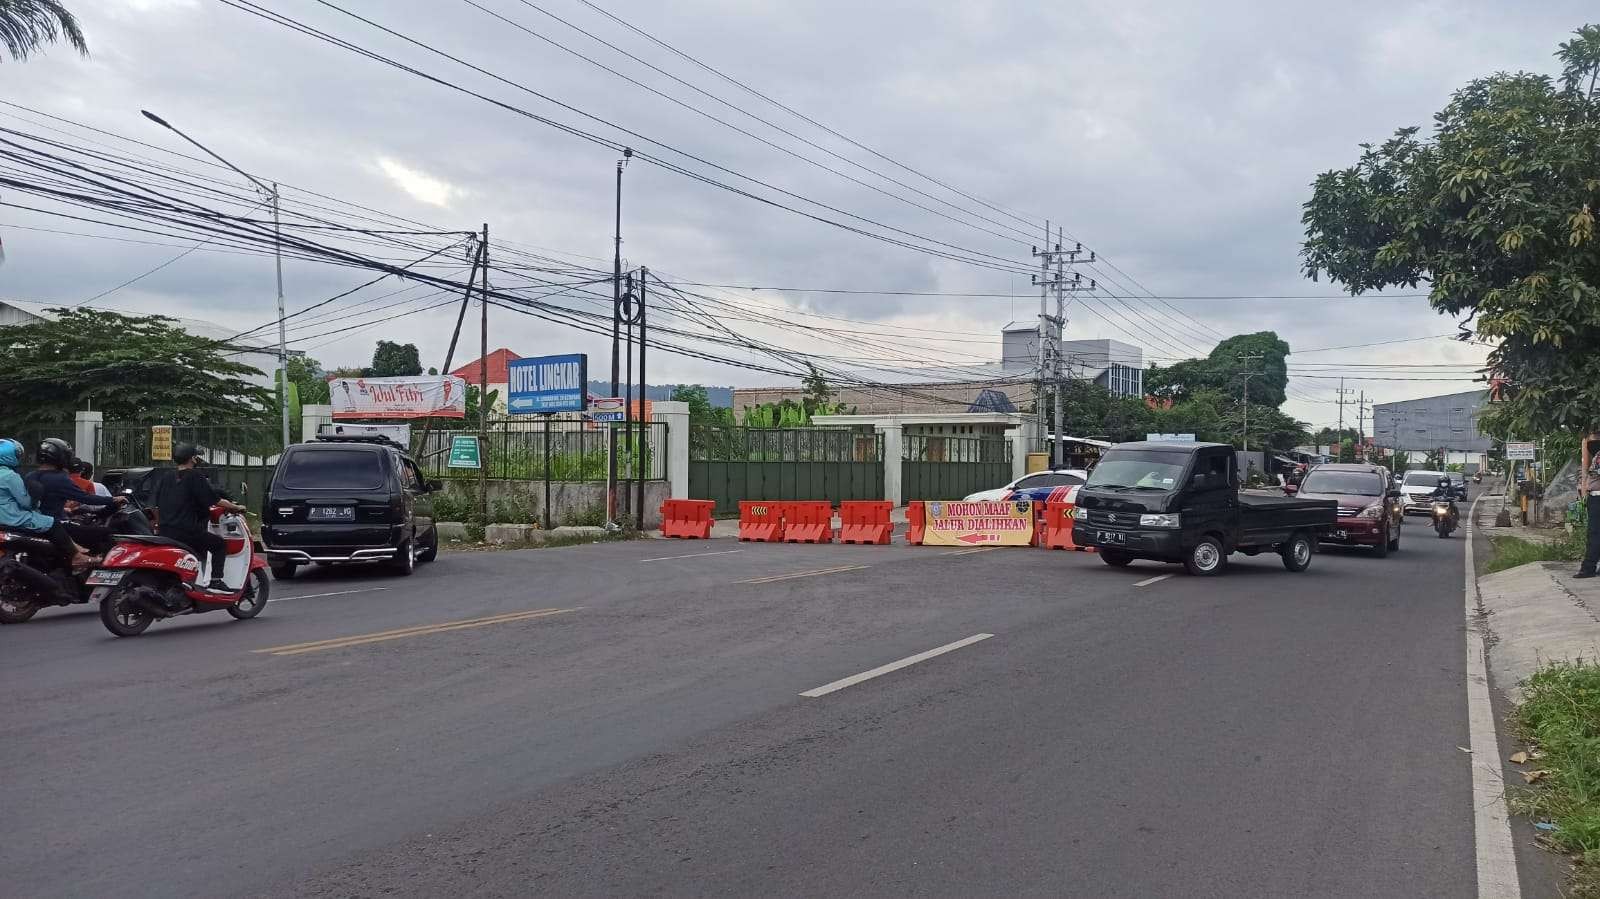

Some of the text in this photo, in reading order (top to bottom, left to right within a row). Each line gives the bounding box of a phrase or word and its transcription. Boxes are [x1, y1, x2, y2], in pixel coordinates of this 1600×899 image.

[510, 362, 579, 393] HOTEL LINGKAR
[946, 503, 1011, 516] MOHON MAAF
[933, 518, 1027, 531] JALUR DIALIHKAN
